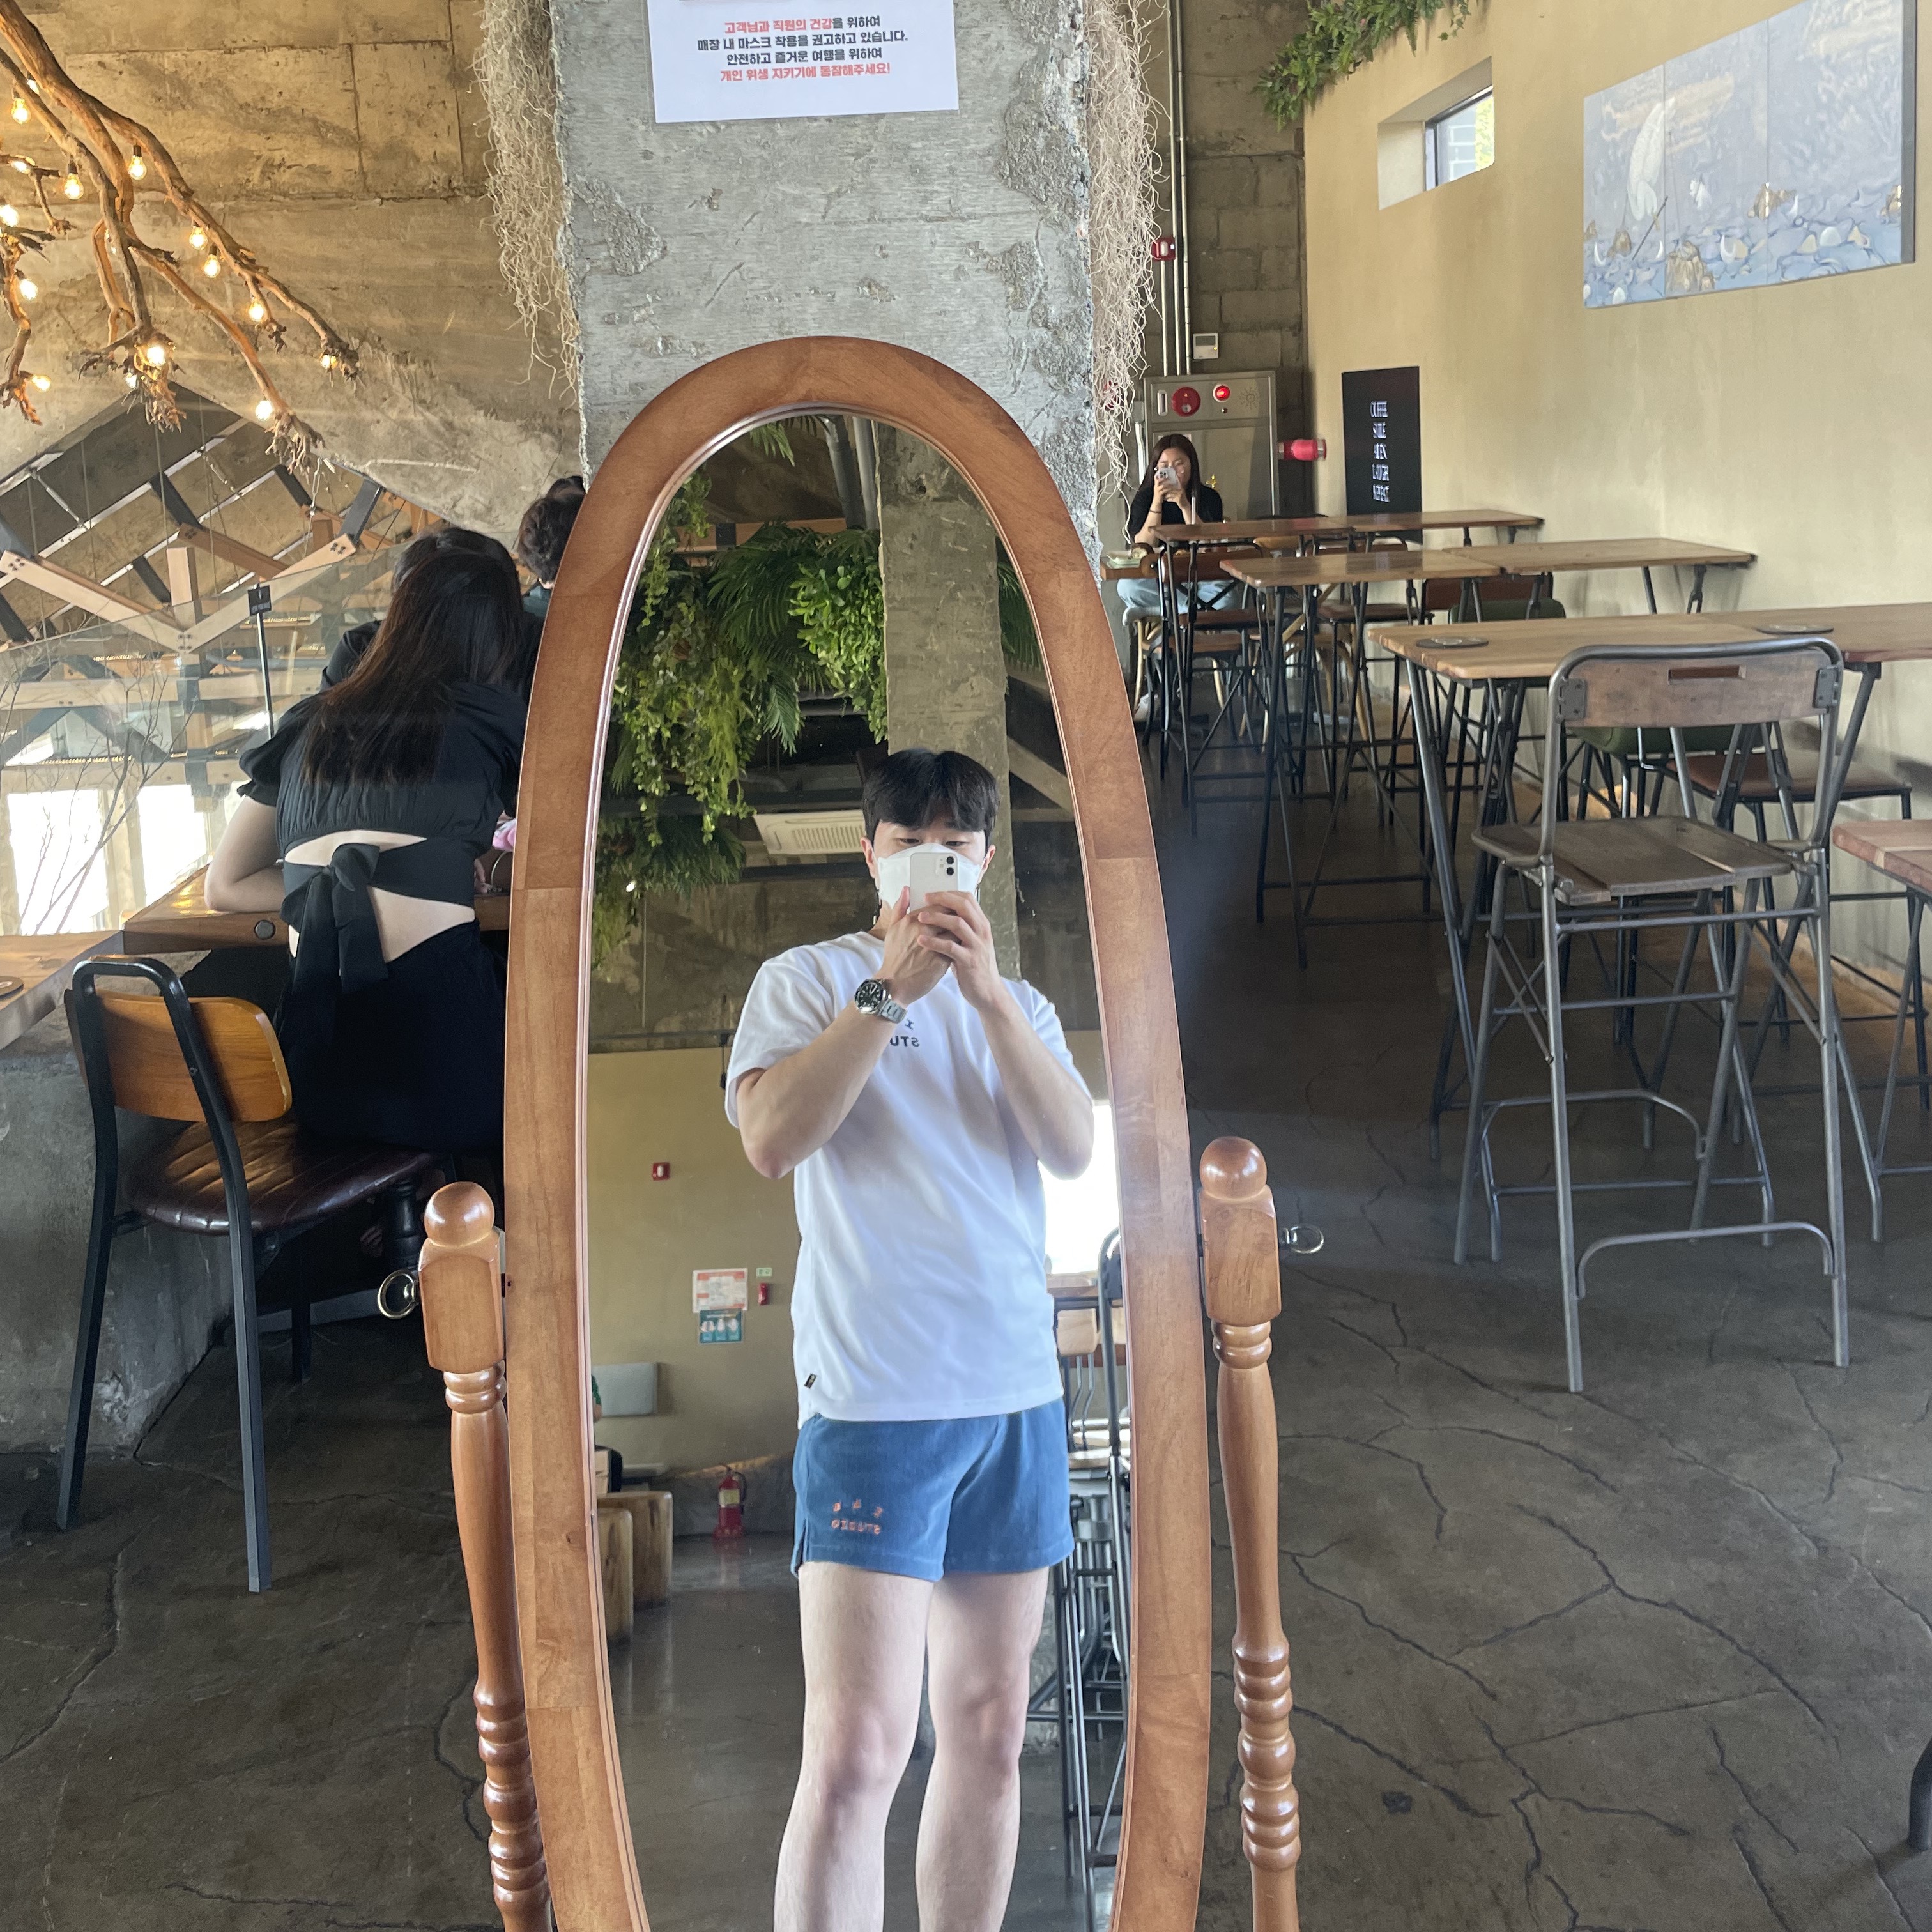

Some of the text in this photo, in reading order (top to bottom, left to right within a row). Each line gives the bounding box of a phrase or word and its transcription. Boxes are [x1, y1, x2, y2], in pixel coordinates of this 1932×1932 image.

[724, 15, 880, 33] 고객님과 직원의 건강을 위하여
[698, 31, 908, 50] 매장 내 마스크 착용을 권고하고 있습니다.
[727, 47, 882, 65] 안전하고 즐거운 여행을 위하여
[721, 63, 890, 82] 개인 위생 지키기에 동참해주세요!
